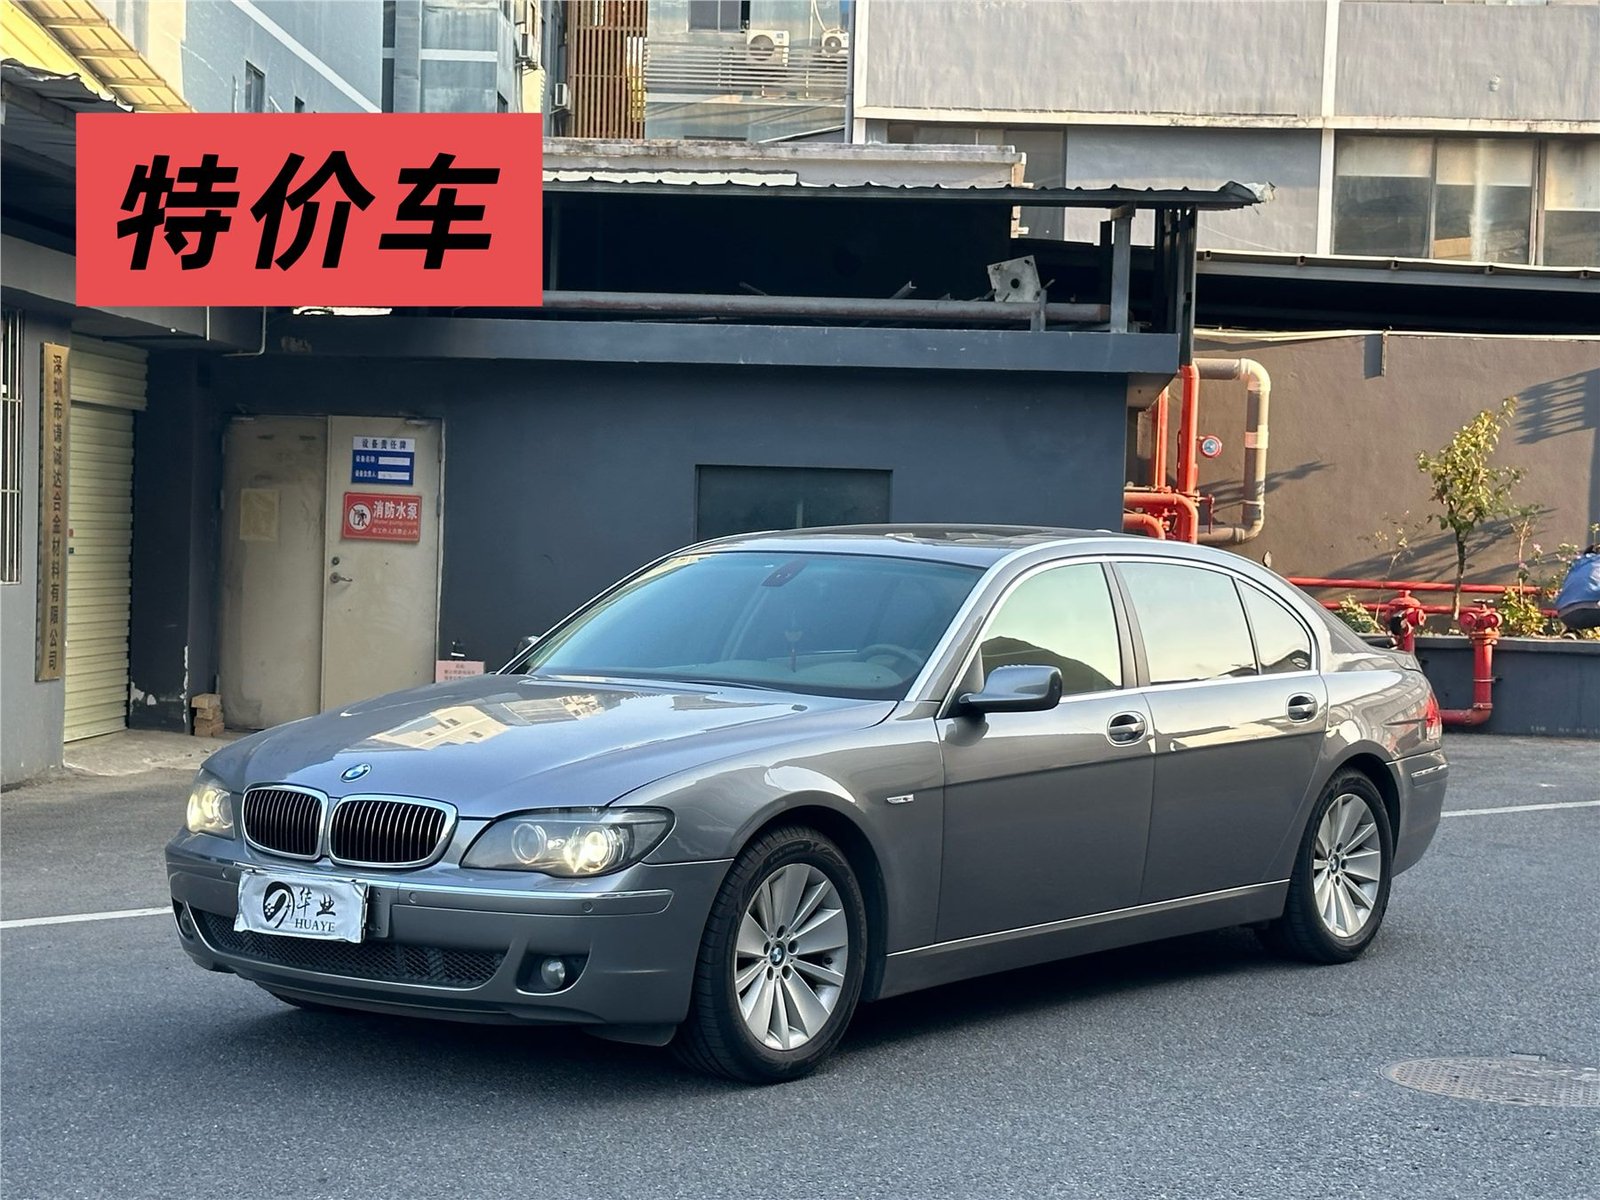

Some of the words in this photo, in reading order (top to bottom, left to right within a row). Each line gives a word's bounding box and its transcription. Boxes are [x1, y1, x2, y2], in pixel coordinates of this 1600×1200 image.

[361, 438, 407, 450] 设备责任牌
[373, 500, 418, 520] 消防水泵
[296, 887, 336, 917] 华业
[295, 918, 336, 932] HUAYE
